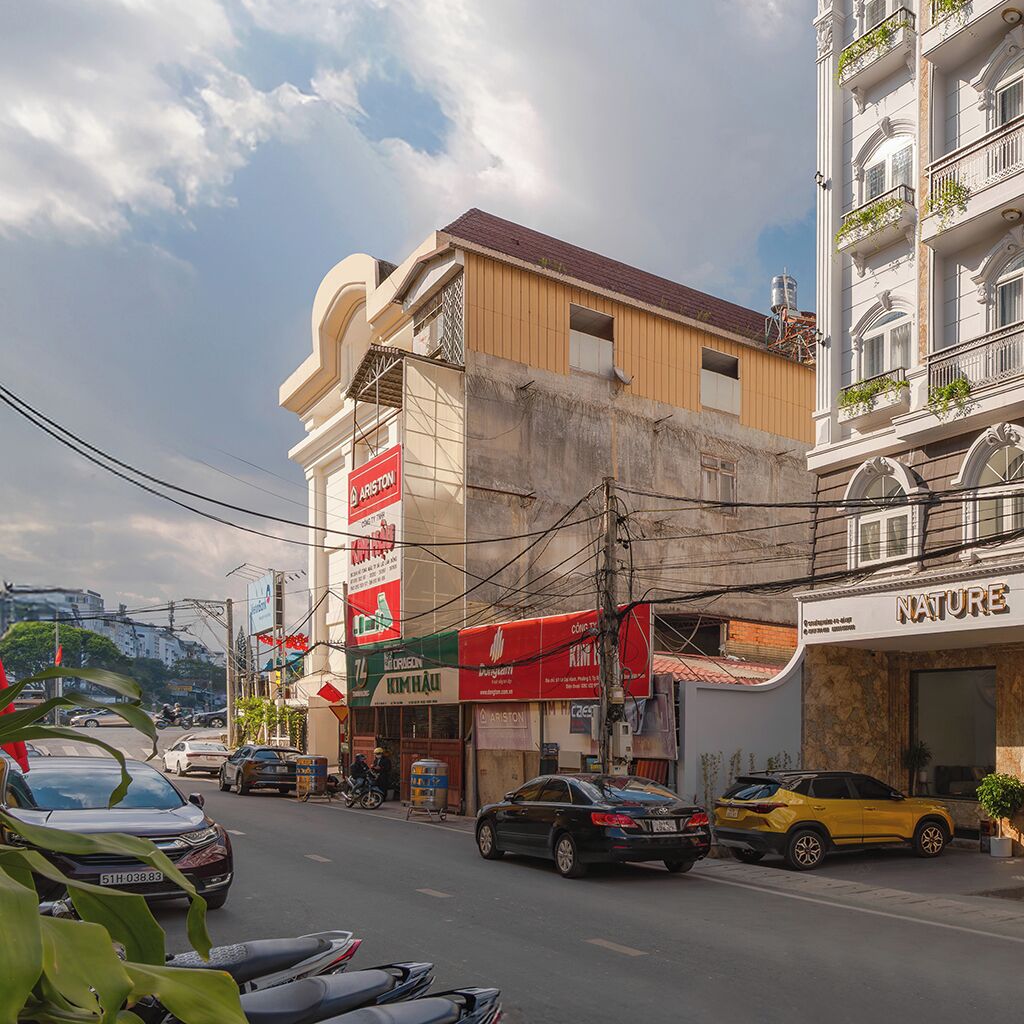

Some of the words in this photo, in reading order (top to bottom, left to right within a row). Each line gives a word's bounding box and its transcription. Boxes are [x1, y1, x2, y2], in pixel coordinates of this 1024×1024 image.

[360, 470, 396, 501] ARISTON
[351, 535, 370, 566] KIM
[371, 519, 395, 560] HẬU
[896, 582, 1009, 623] NATURE
[393, 656, 423, 670] DRAGON
[569, 643, 591, 667] KIM
[387, 676, 411, 695] KIM
[411, 671, 441, 696] HẬU
[490, 711, 525, 723] ARISTON
[102, 872, 162, 884] 51H-038.83
